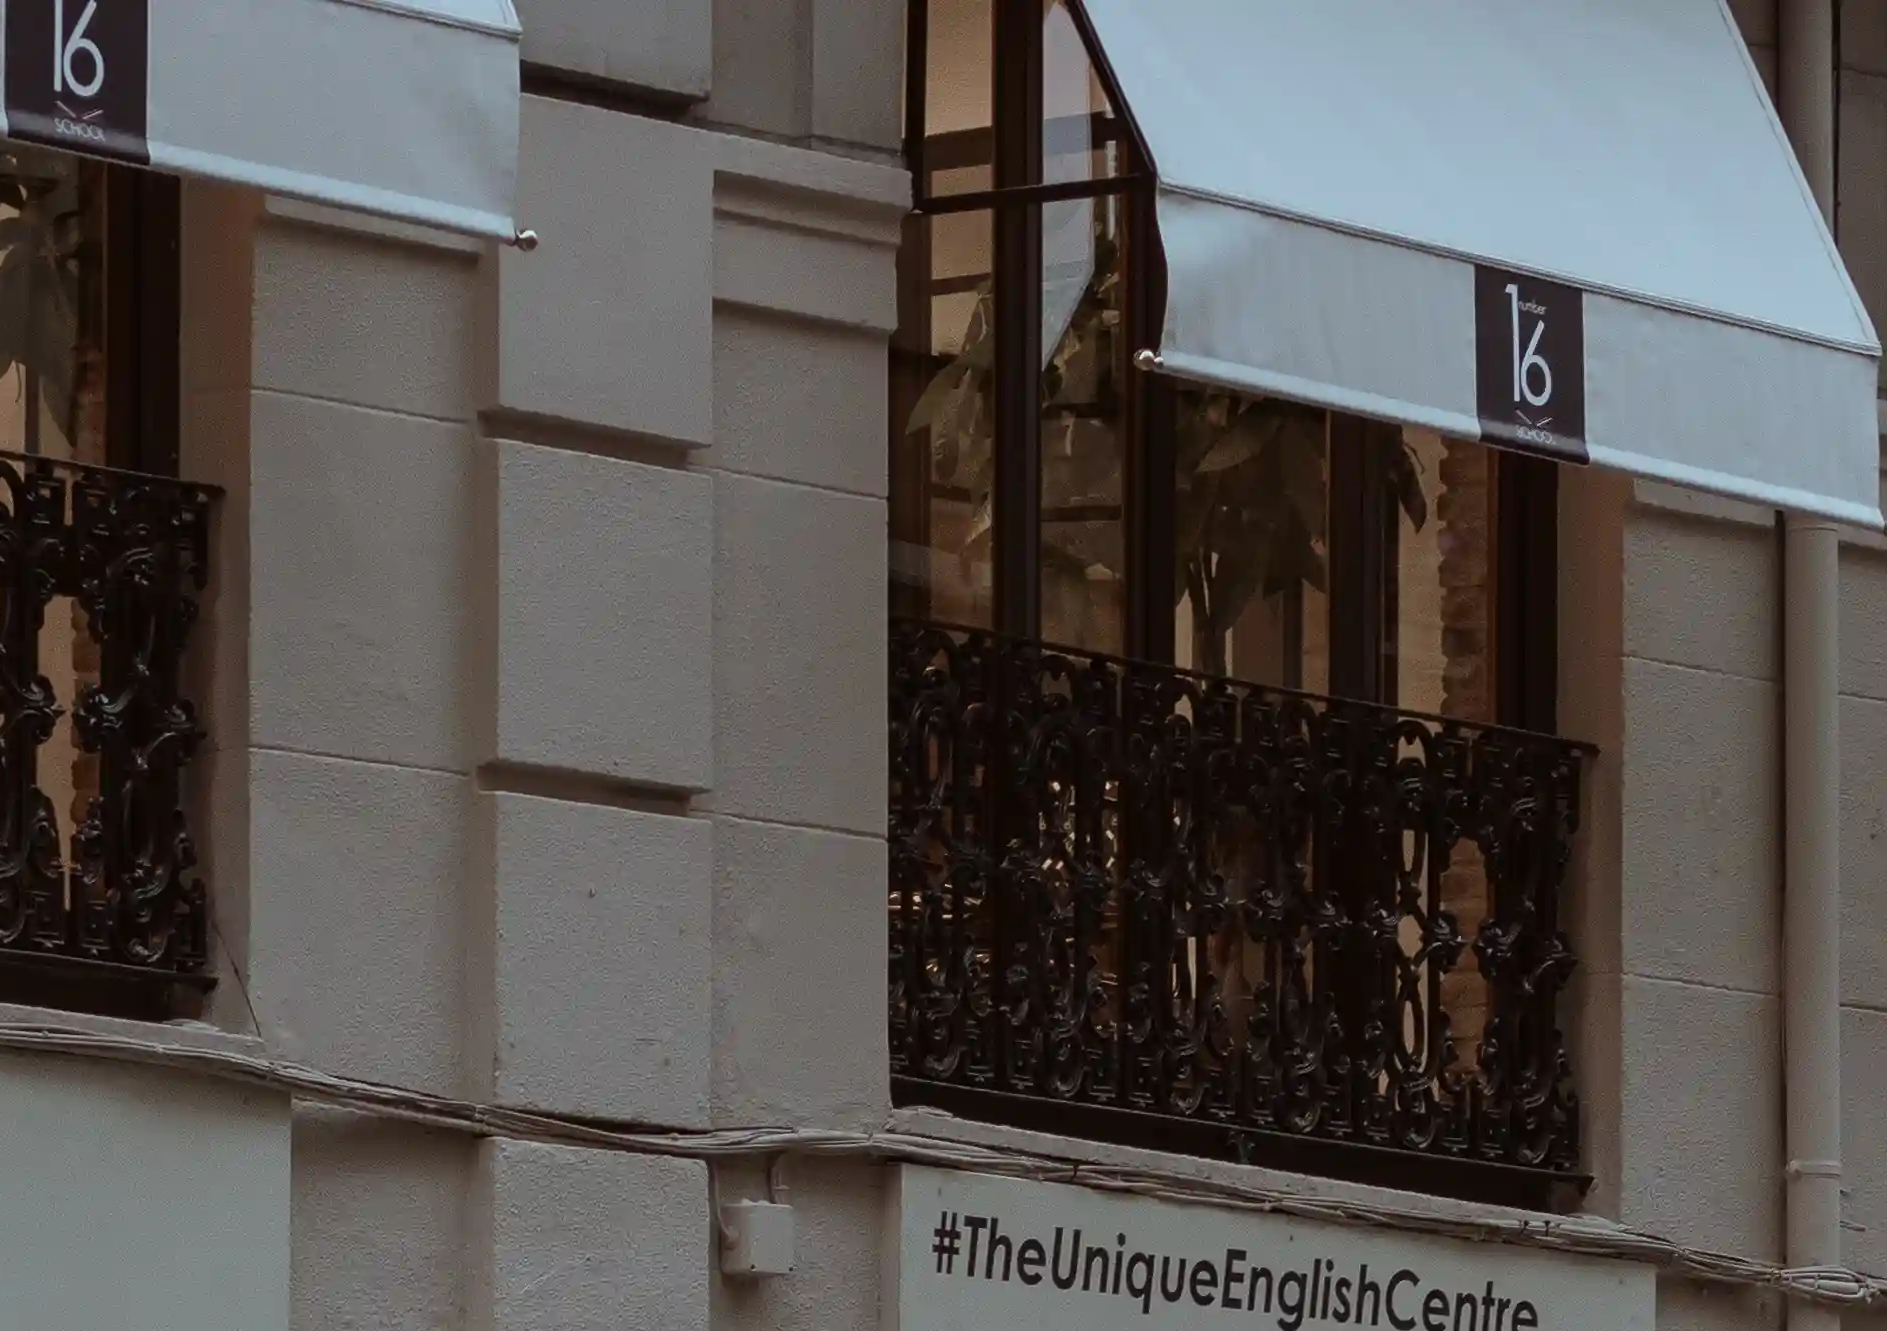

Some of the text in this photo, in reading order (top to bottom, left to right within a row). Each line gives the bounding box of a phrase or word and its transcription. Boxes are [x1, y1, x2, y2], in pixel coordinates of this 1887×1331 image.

[53, 0, 105, 97] 16
[53, 116, 106, 142] SCHOOL
[1504, 283, 1553, 407] 16
